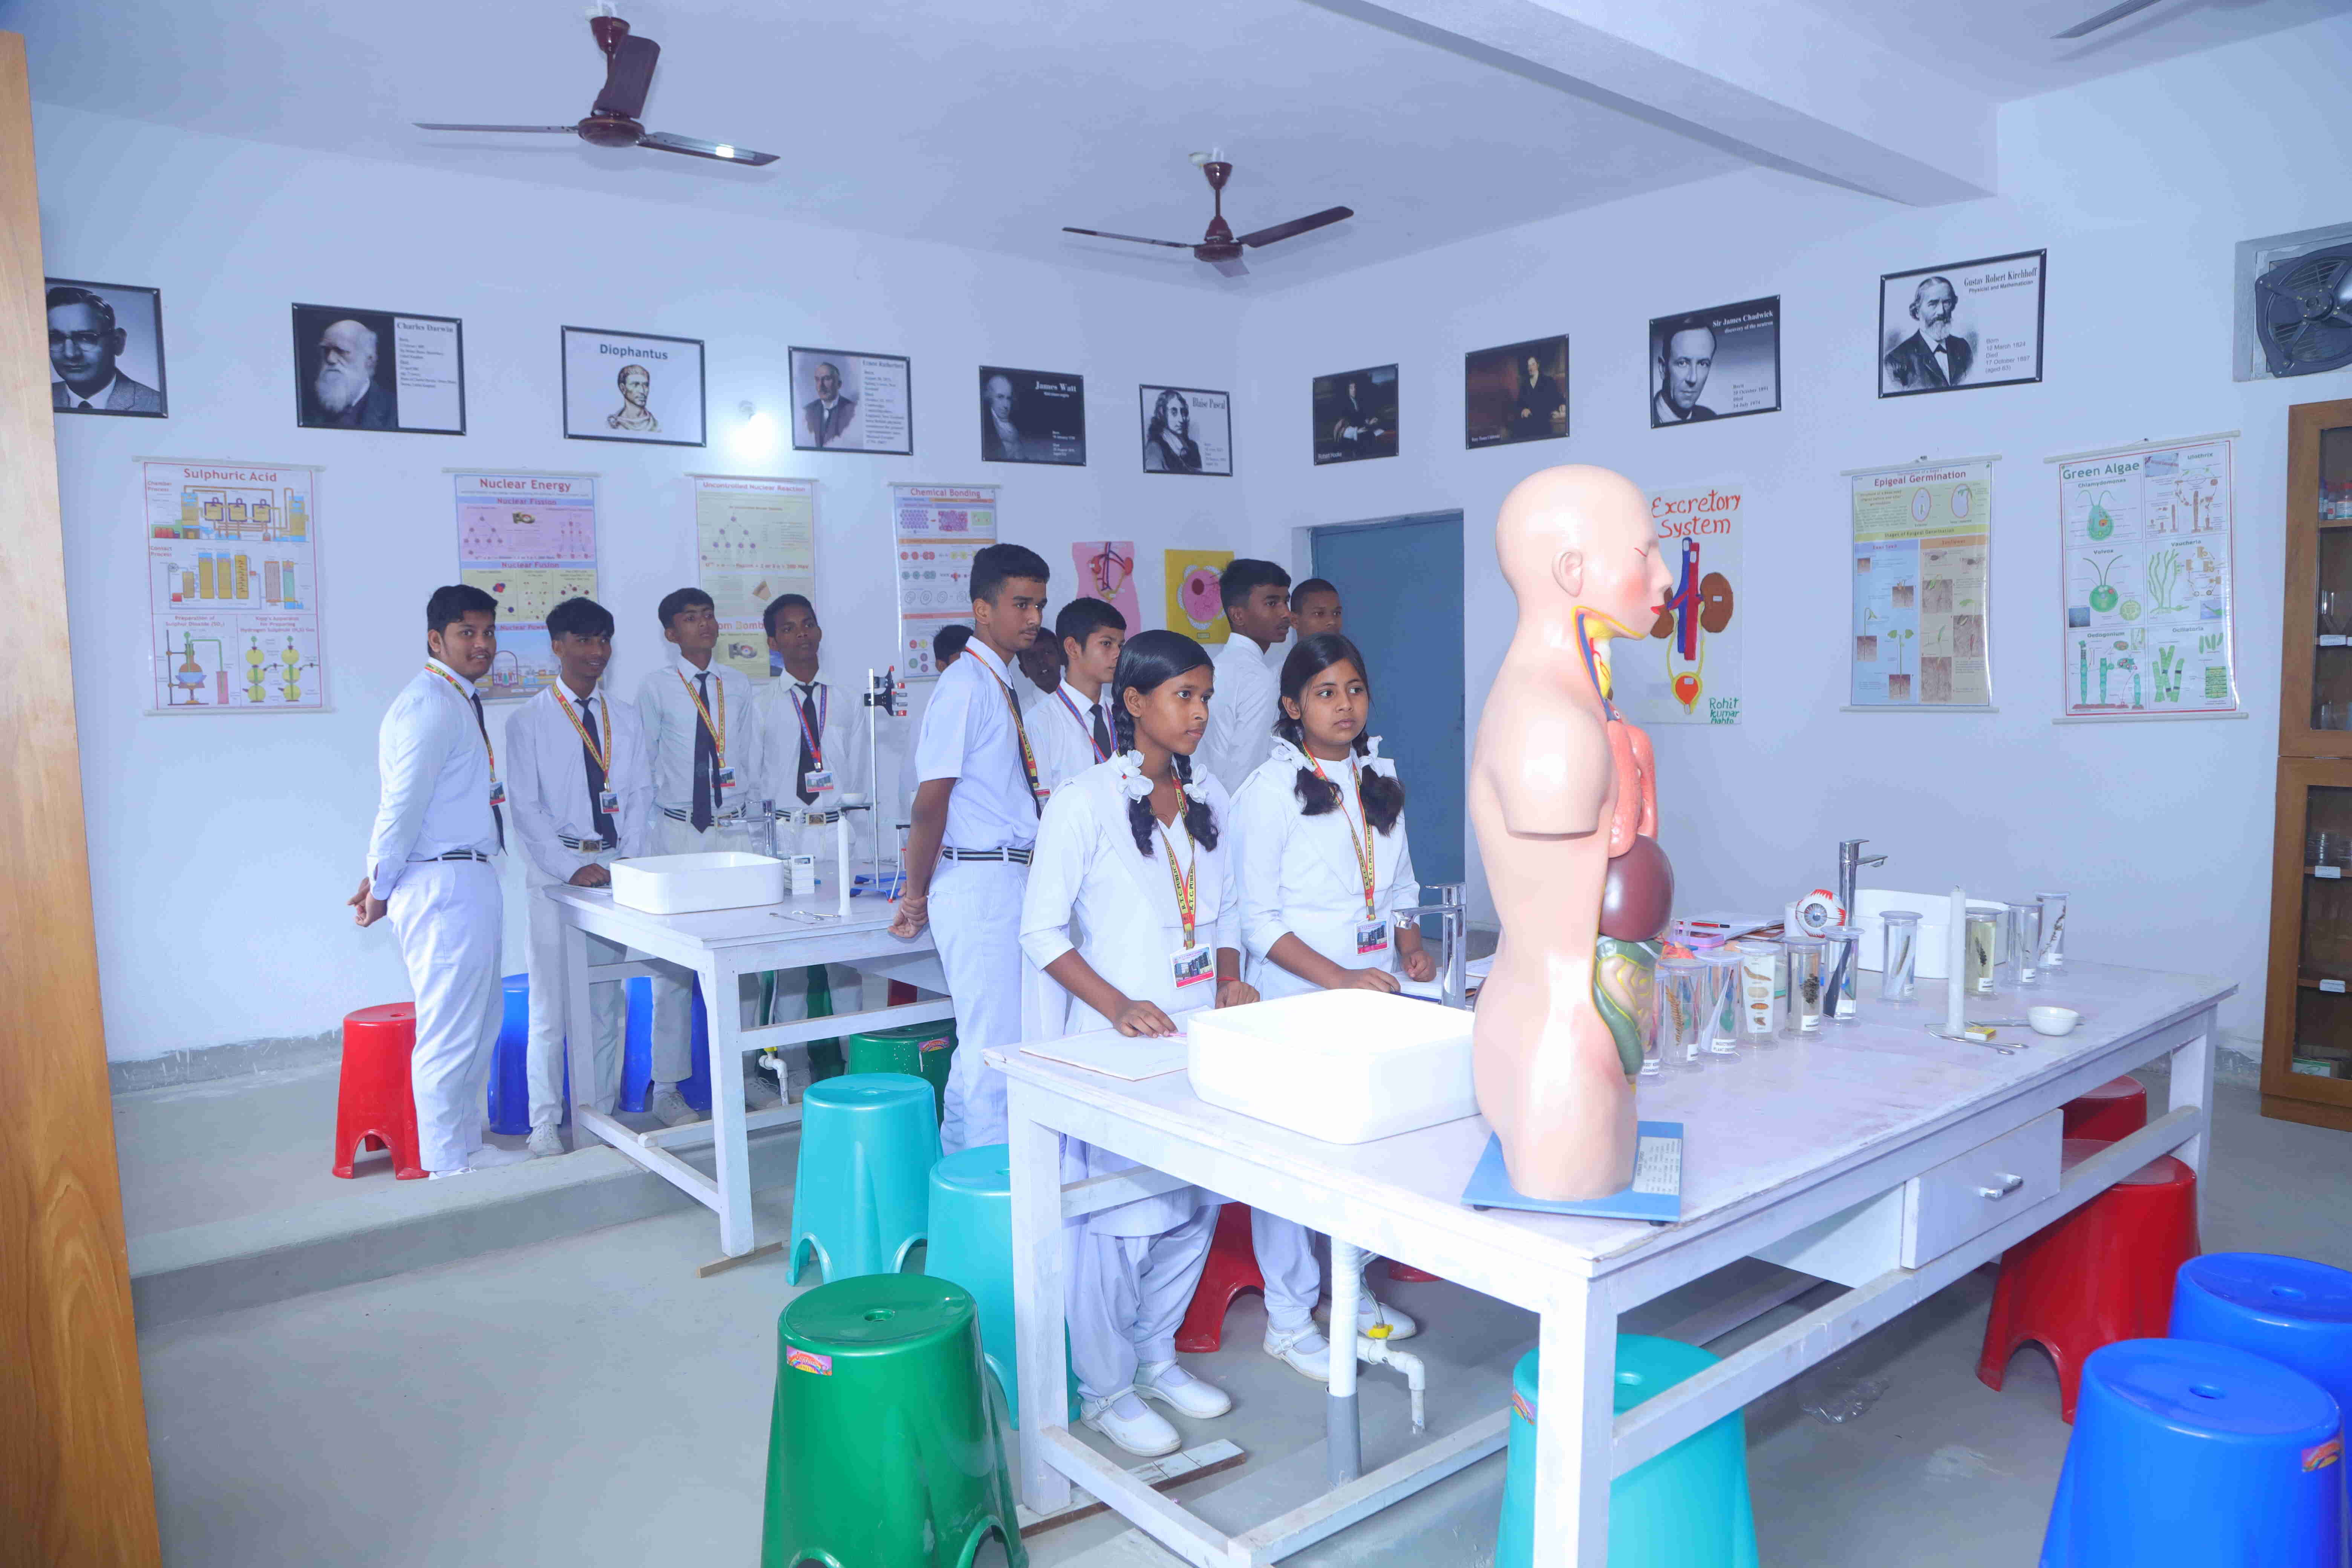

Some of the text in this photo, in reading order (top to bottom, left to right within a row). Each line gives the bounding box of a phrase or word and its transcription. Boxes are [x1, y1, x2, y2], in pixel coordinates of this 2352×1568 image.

[1964, 267, 2038, 287] Gustav Robert Kirchhoff
[2000, 280, 2034, 289] Mathematician
[1713, 319, 1721, 328] Sir
[1743, 310, 1773, 322] Chadwick
[397, 322, 425, 331] Charles
[600, 344, 668, 360] Diophantus
[1035, 381, 1076, 392] James Watt
[1193, 397, 1207, 407] Blaise
[184, 468, 277, 482] Sulphuric Acid
[2063, 462, 2140, 480] Green Algae
[480, 479, 571, 492] Nuclear Energy
[1874, 470, 1966, 487] Epigeal Germination
[2078, 478, 2126, 488] Chlamydomonas
[910, 488, 981, 498] Chemical Bonding
[1652, 490, 1741, 518] Excretory
[1658, 516, 1731, 538] System
[1709, 697, 1740, 710] Rohit
[1172, 866, 1182, 889] PUBLIC
